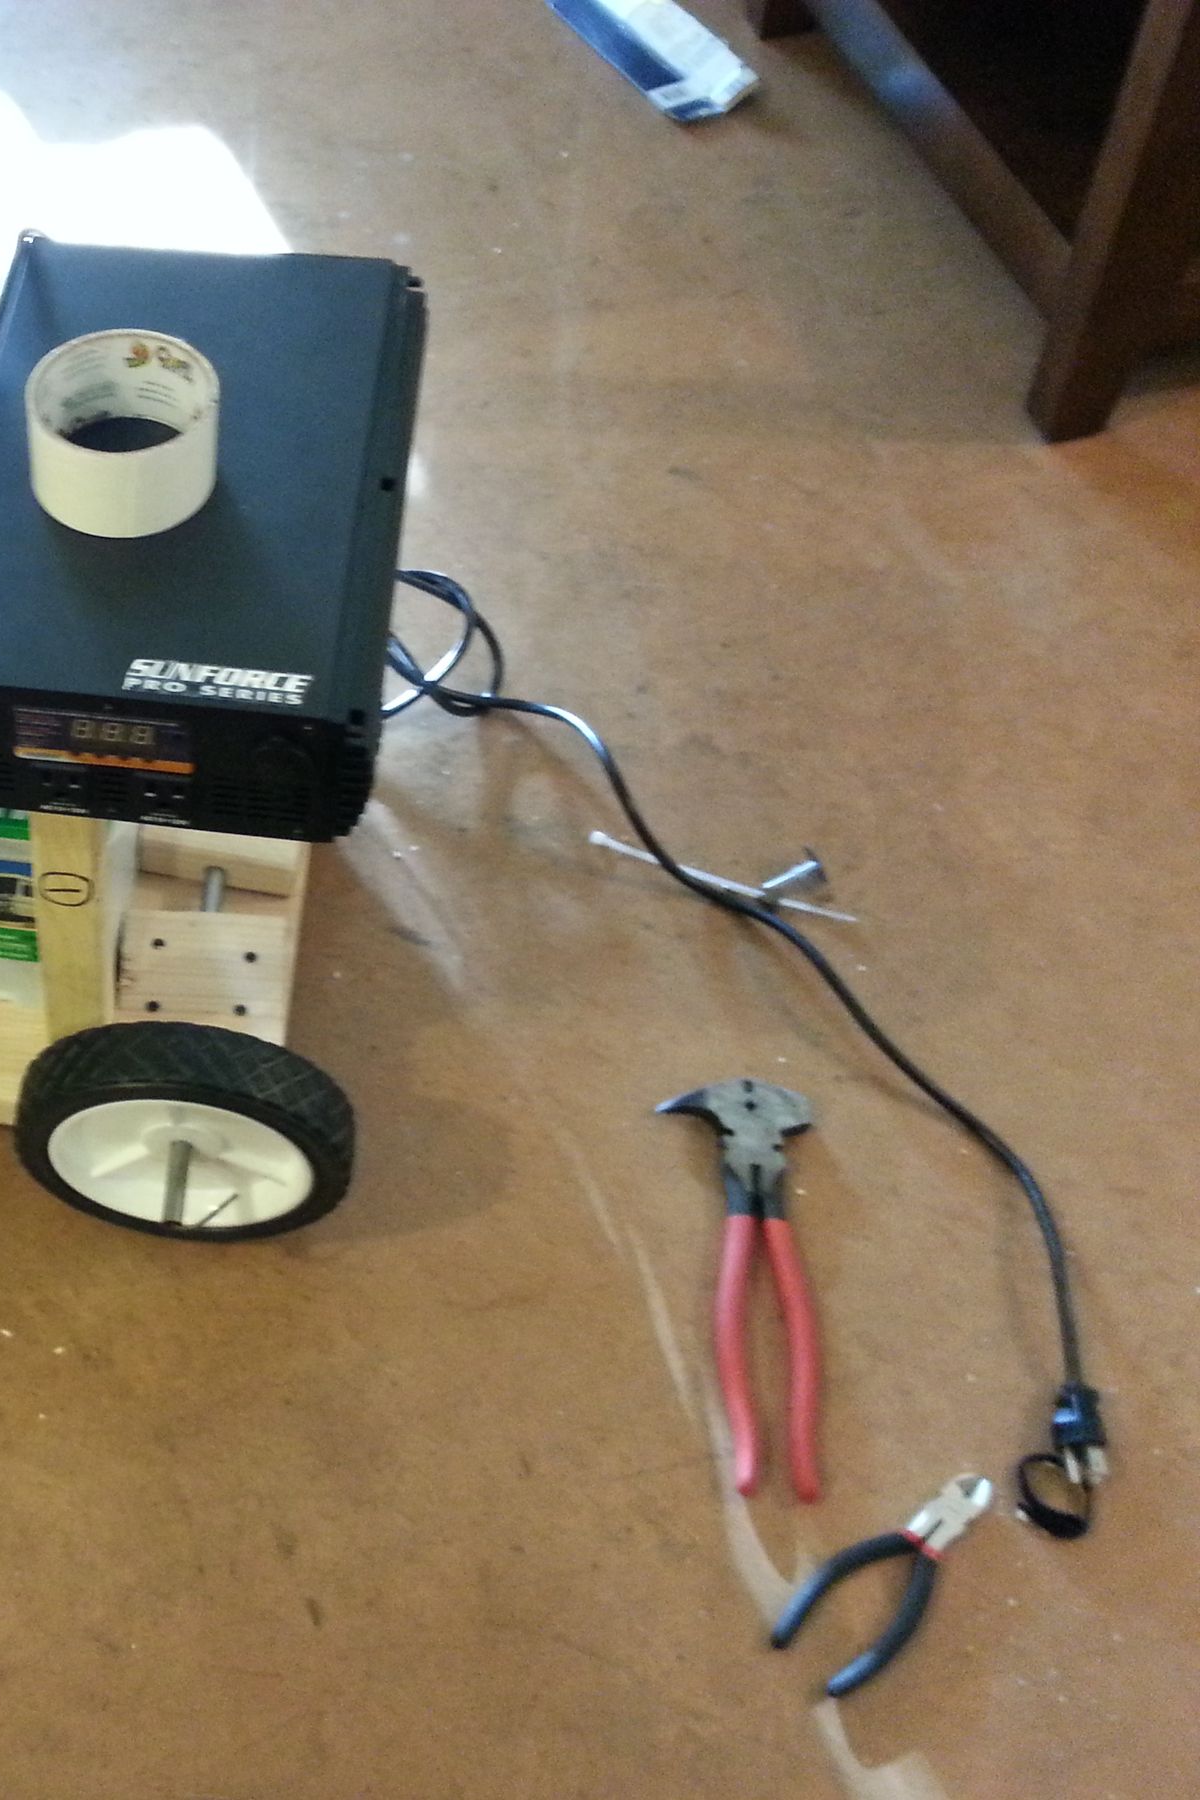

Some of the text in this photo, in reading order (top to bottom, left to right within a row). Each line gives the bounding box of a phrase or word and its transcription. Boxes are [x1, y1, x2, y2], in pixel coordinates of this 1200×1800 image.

[122, 677, 303, 705] PRO SERIES
[128, 659, 314, 693] SUNFORCE
